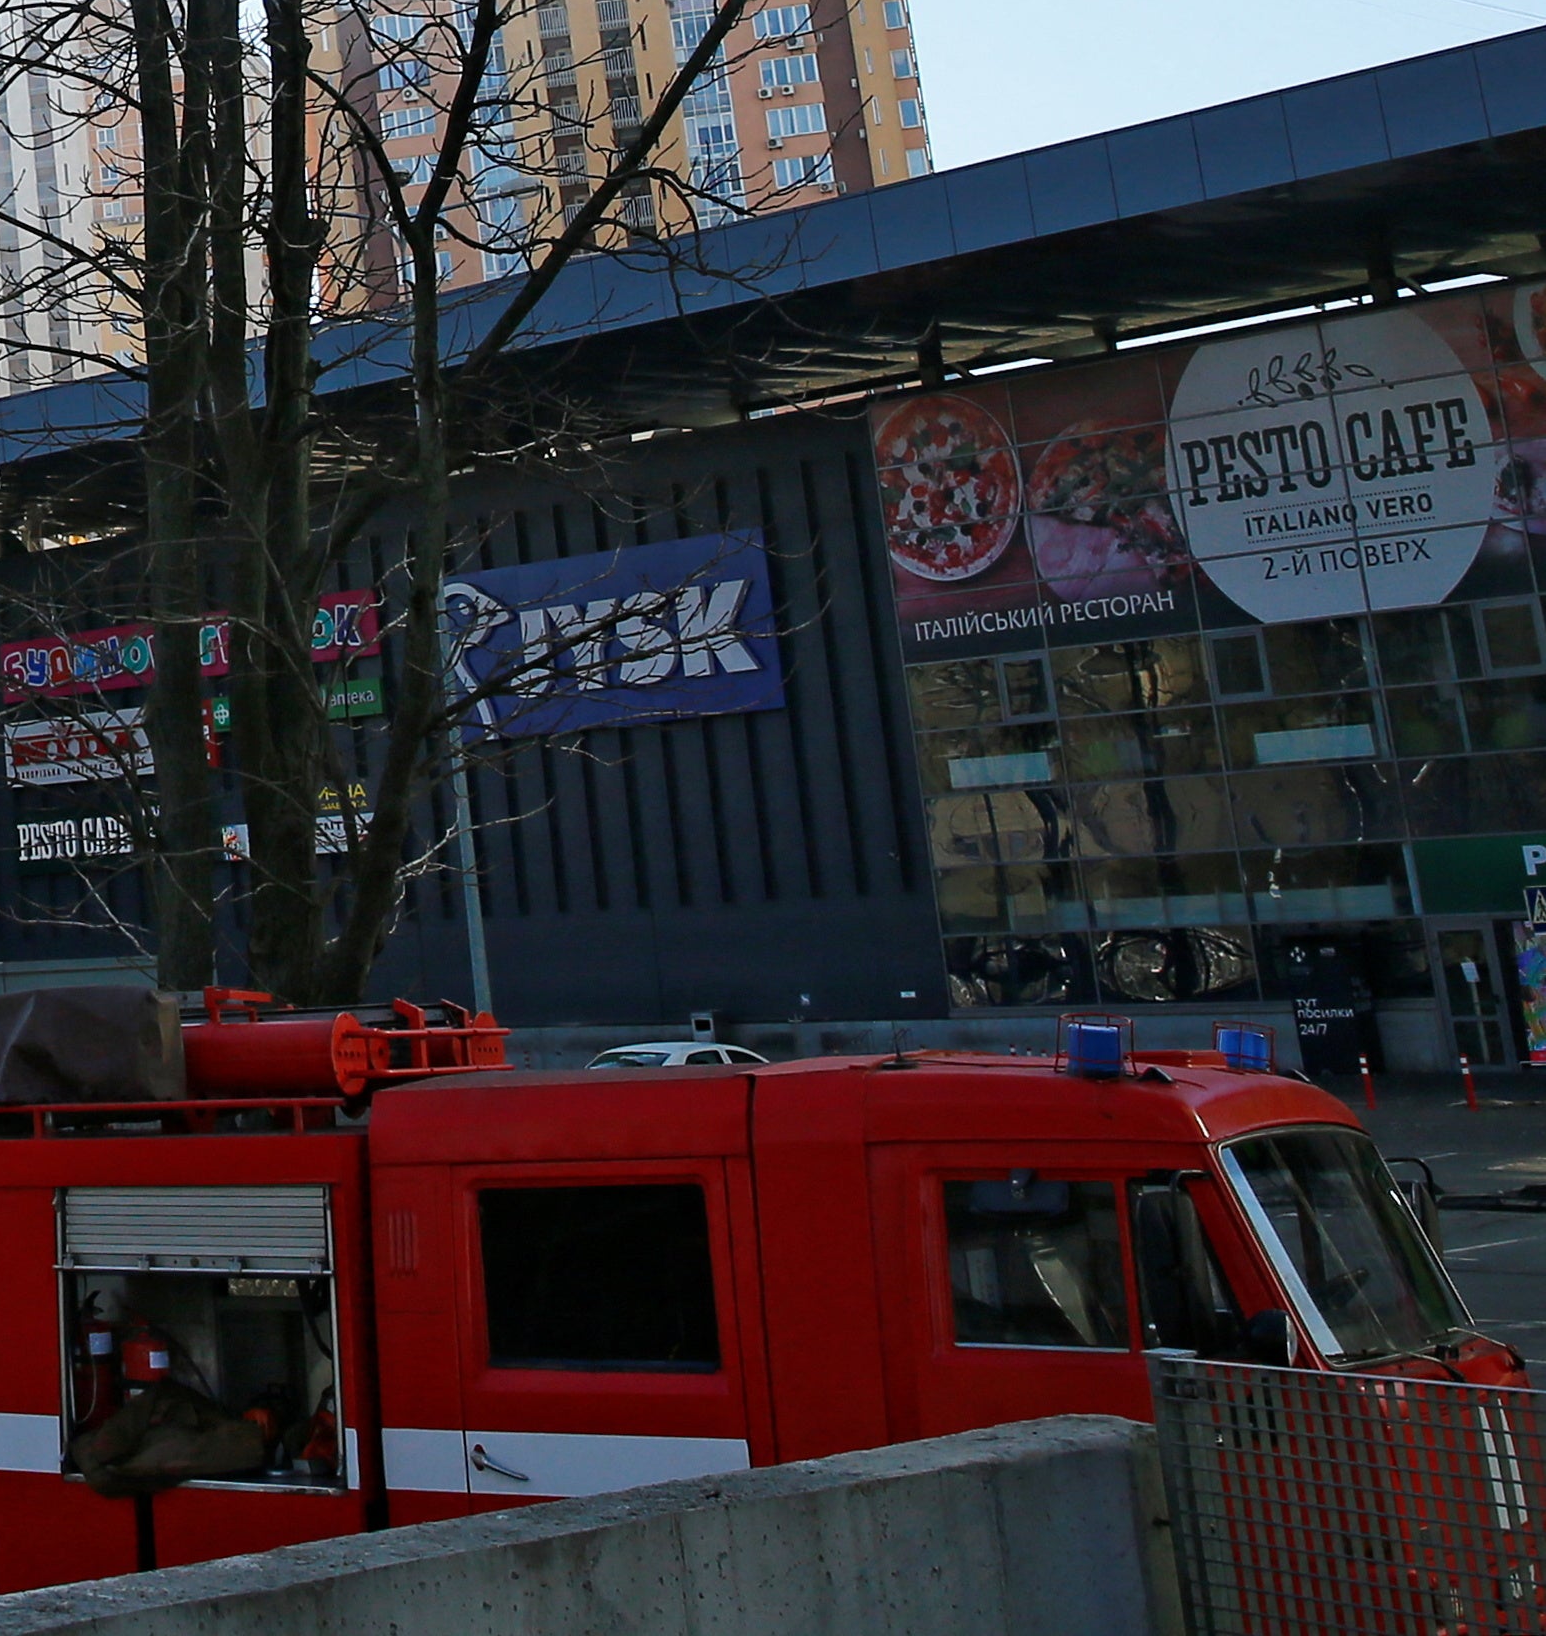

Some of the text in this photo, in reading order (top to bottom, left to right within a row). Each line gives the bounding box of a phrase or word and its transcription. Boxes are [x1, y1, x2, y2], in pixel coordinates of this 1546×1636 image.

[1180, 397, 1476, 507] PESTO CAFE
[1244, 492, 1434, 537] ITALIANO VERO
[1262, 538, 1432, 580] 2-Й ПОВЕРХ
[915, 590, 1175, 642] ІТАЛІЙСЬКИЙ РЕСТОРАН
[17, 820, 77, 862] PESTO
[1300, 1023, 1328, 1036] 24/7
